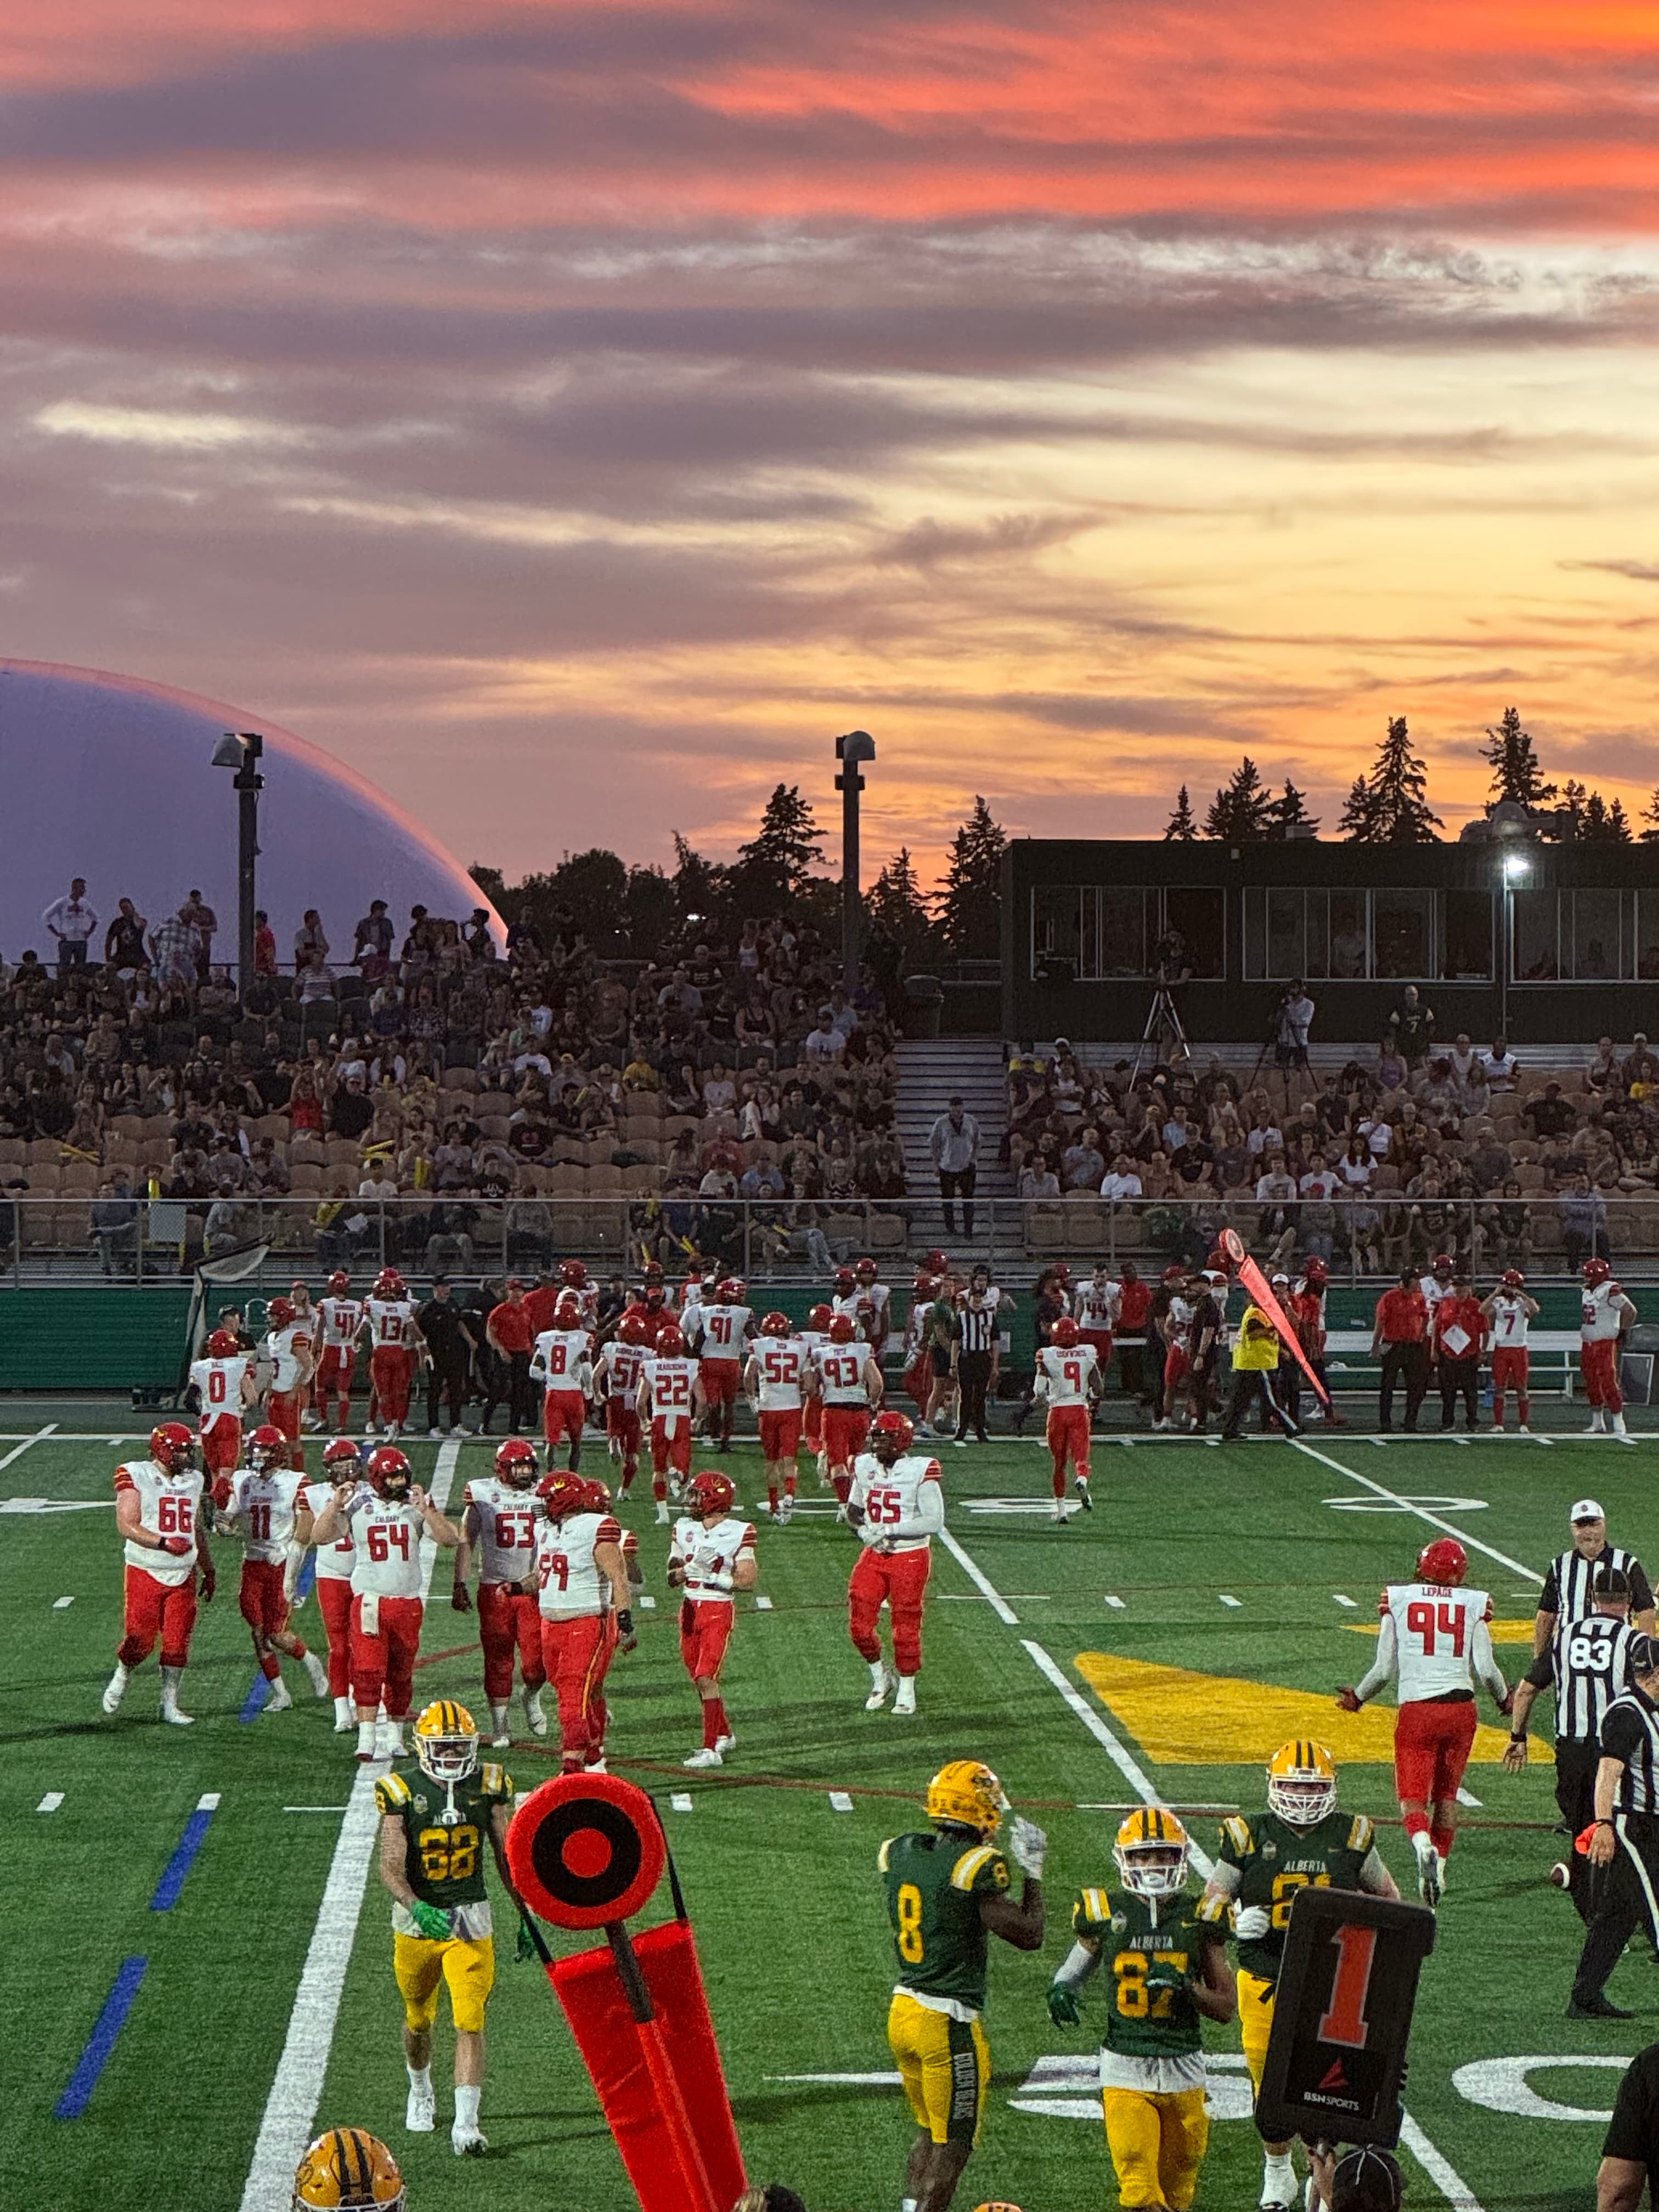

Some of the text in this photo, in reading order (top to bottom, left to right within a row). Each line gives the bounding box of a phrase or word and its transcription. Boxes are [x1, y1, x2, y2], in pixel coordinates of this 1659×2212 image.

[381, 1316, 402, 1340] 13
[710, 1317, 732, 1343] 91
[1504, 1314, 1515, 1335] 7
[551, 1345, 566, 1374] 8
[612, 1357, 639, 1389] 51
[765, 1352, 798, 1383] 52
[825, 1357, 859, 1387] 93
[210, 1372, 225, 1403] 0
[656, 1375, 689, 1406] 22
[1064, 1362, 1081, 1393] 9
[159, 1497, 192, 1533] 66
[867, 1489, 901, 1523] 65
[250, 1505, 270, 1539] 11
[495, 1513, 535, 1548] 63
[368, 1524, 409, 1561] 64
[1422, 1587, 1453, 1598] LEPAGE
[1408, 1602, 1465, 1657] 94
[1570, 1638, 1612, 1671] 83
[1284, 1860, 1327, 1874] ALBERTA
[898, 1883, 924, 1963] 8
[1129, 1935, 1173, 1950] ALBERTA
[1114, 1951, 1188, 2018] 87
[1318, 1922, 1378, 2049] 1
